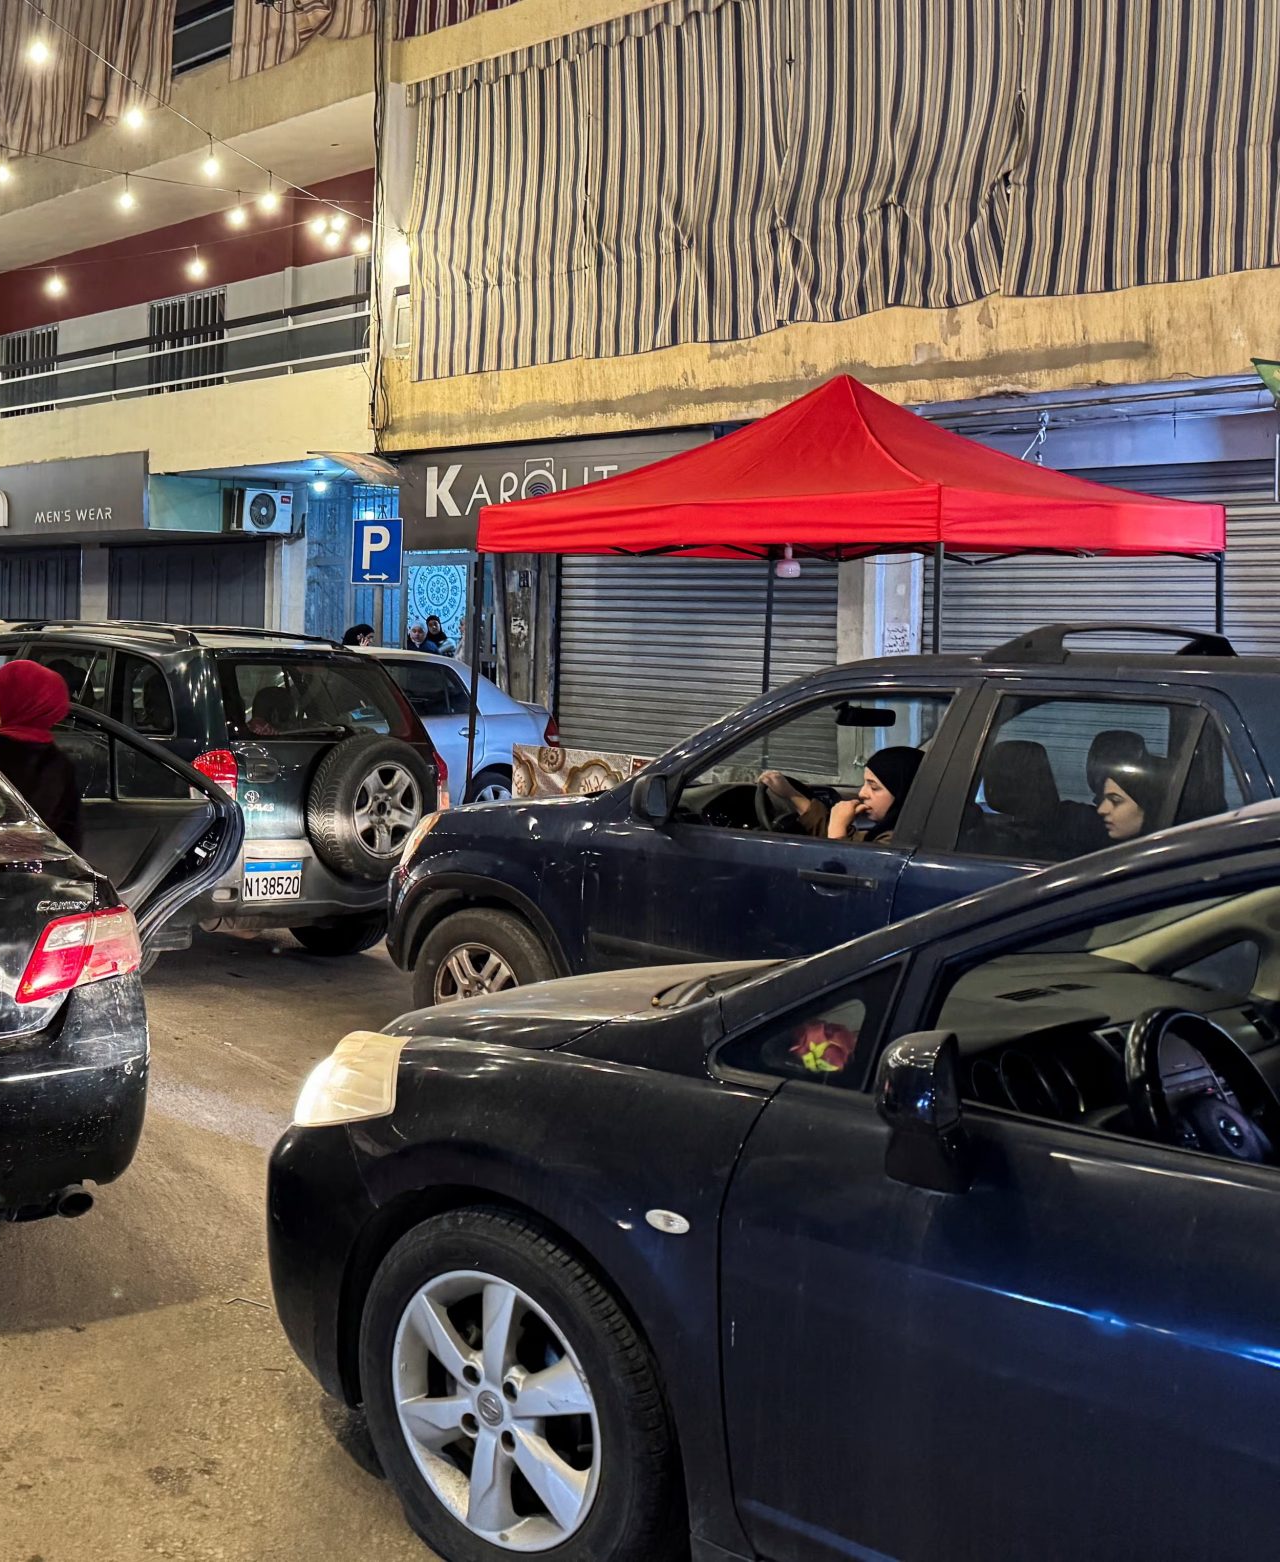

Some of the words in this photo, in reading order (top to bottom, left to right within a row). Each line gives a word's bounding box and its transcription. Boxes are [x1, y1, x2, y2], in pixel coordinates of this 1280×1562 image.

[34, 509, 71, 524] MEN'S
[75, 507, 112, 521] WEAR
[362, 526, 390, 570] P
[245, 876, 300, 897] N138520
